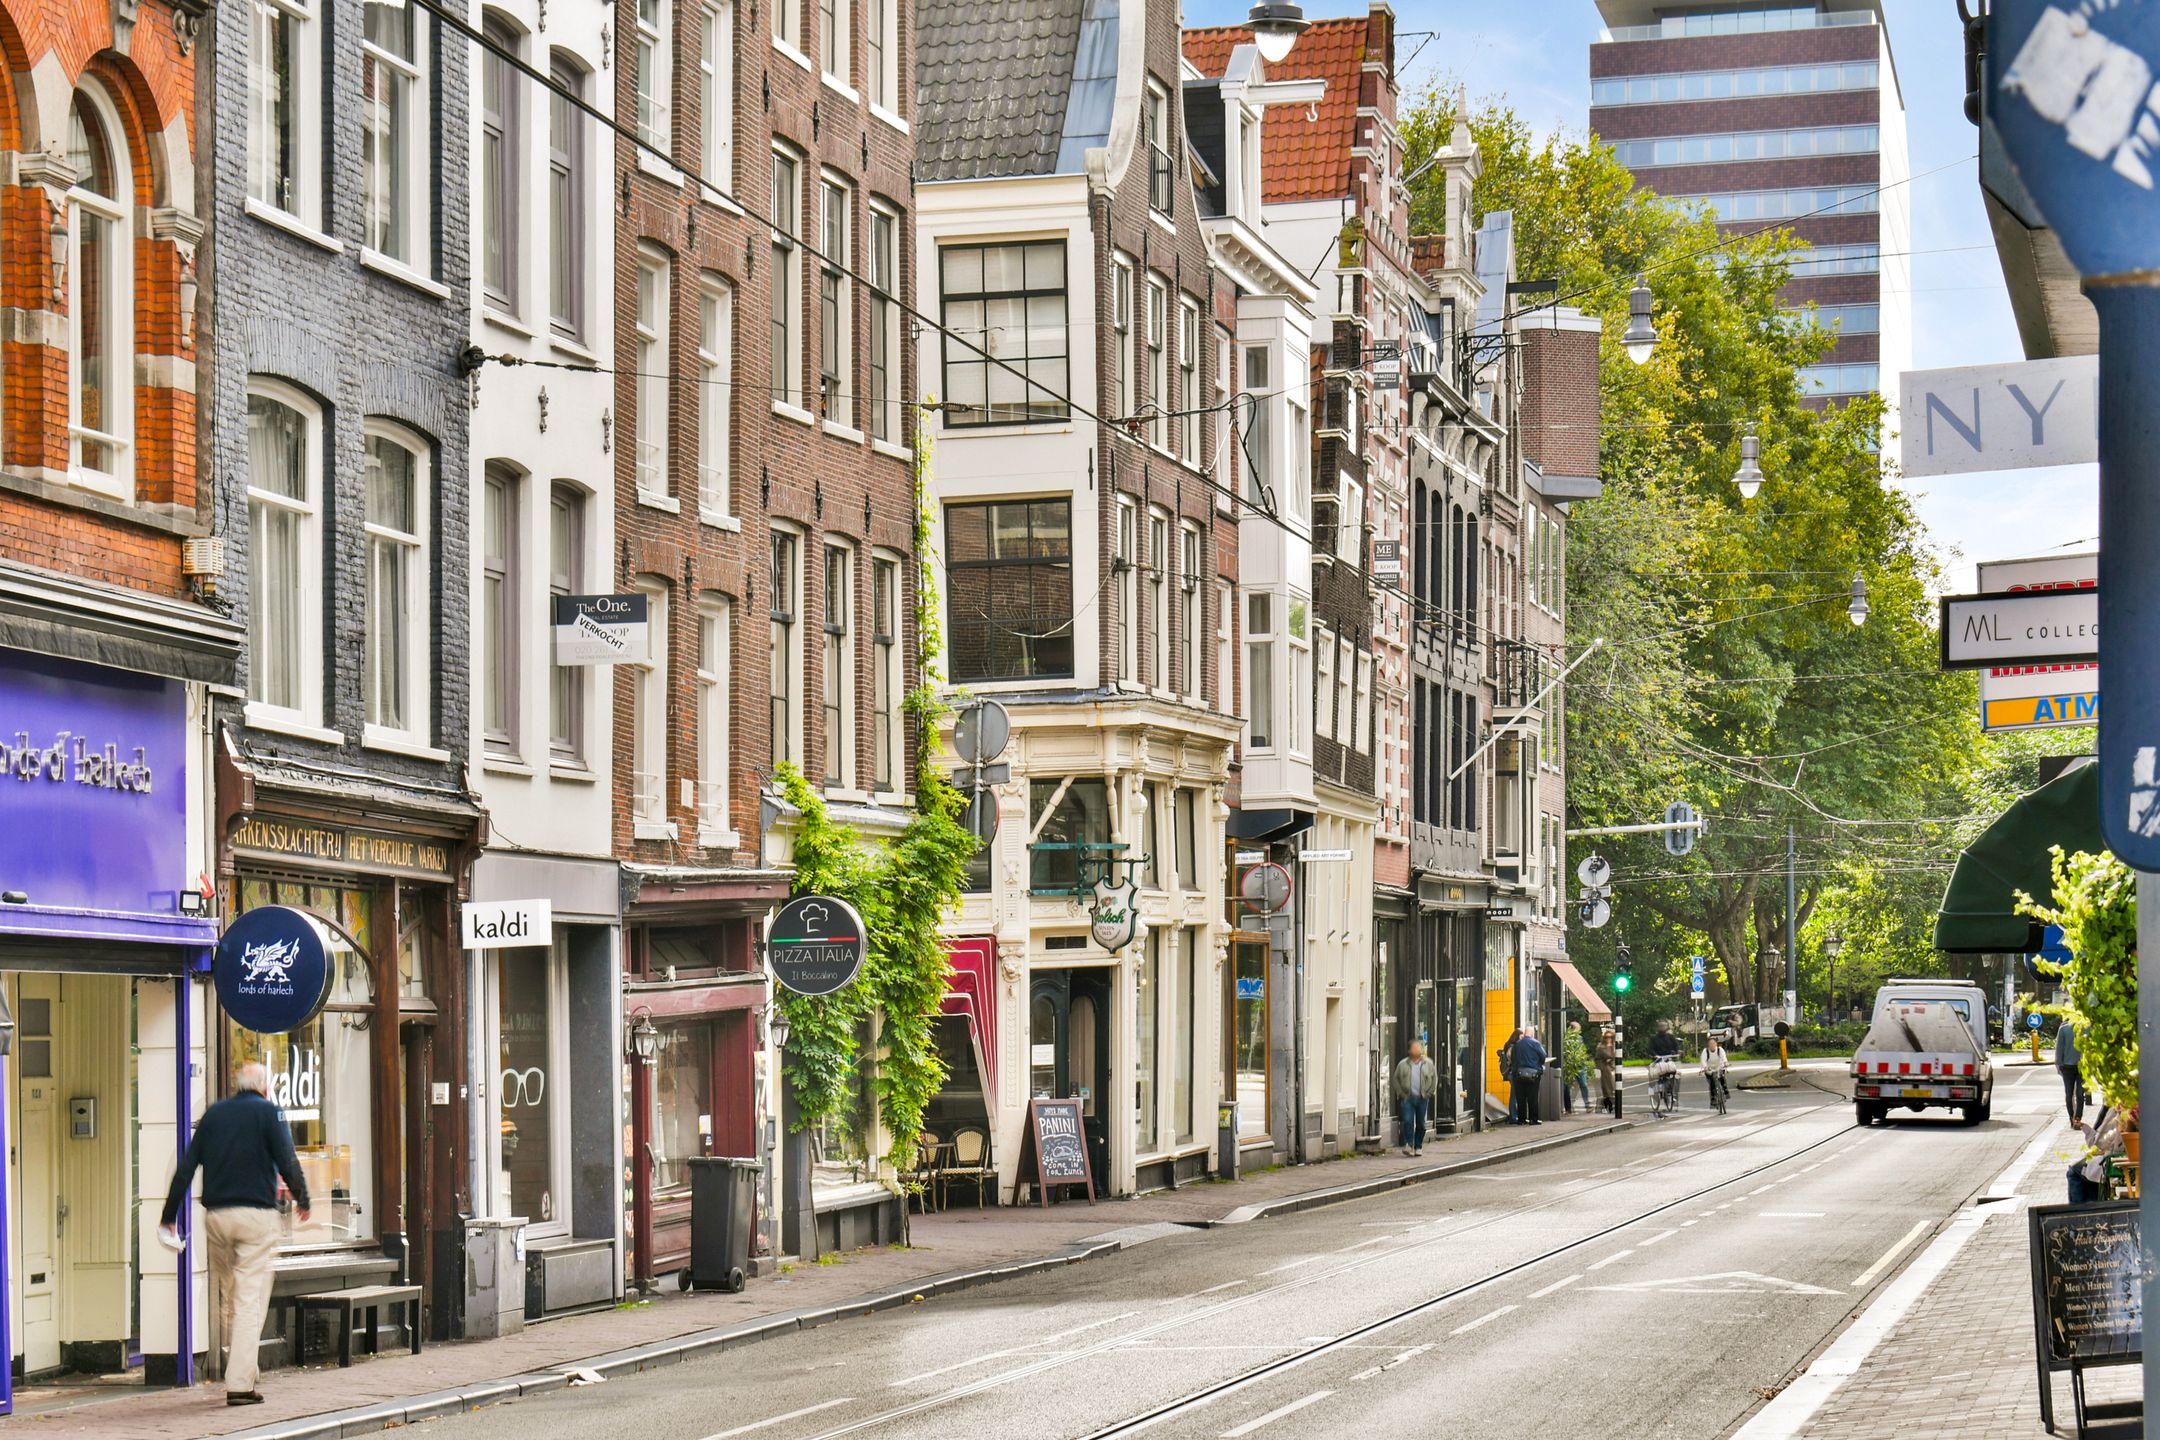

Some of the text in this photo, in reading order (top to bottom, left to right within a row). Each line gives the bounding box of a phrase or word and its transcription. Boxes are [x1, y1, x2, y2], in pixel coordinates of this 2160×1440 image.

[1926, 376, 2098, 456] NY
[1376, 544, 1392, 554] ME
[576, 597, 631, 613] The One.
[579, 617, 624, 650] VERKOCHT
[1963, 614, 2012, 642] ML
[2033, 694, 2098, 721] ATM
[349, 835, 367, 860] HET
[369, 837, 414, 867] VERGULDE
[418, 844, 447, 871] VARKEN
[473, 909, 528, 939] kaldi
[774, 945, 854, 963] PIZZA ITALIA
[801, 970, 838, 980] Boccalino
[238, 983, 294, 996] lords of harlech
[265, 1044, 321, 1107] kaldi
[1039, 1117, 1076, 1136] PANINI
[2075, 1232, 2094, 1246] Hair
[2062, 1261, 2093, 1272] Women's
[2087, 1281, 2113, 1291] Haircut
